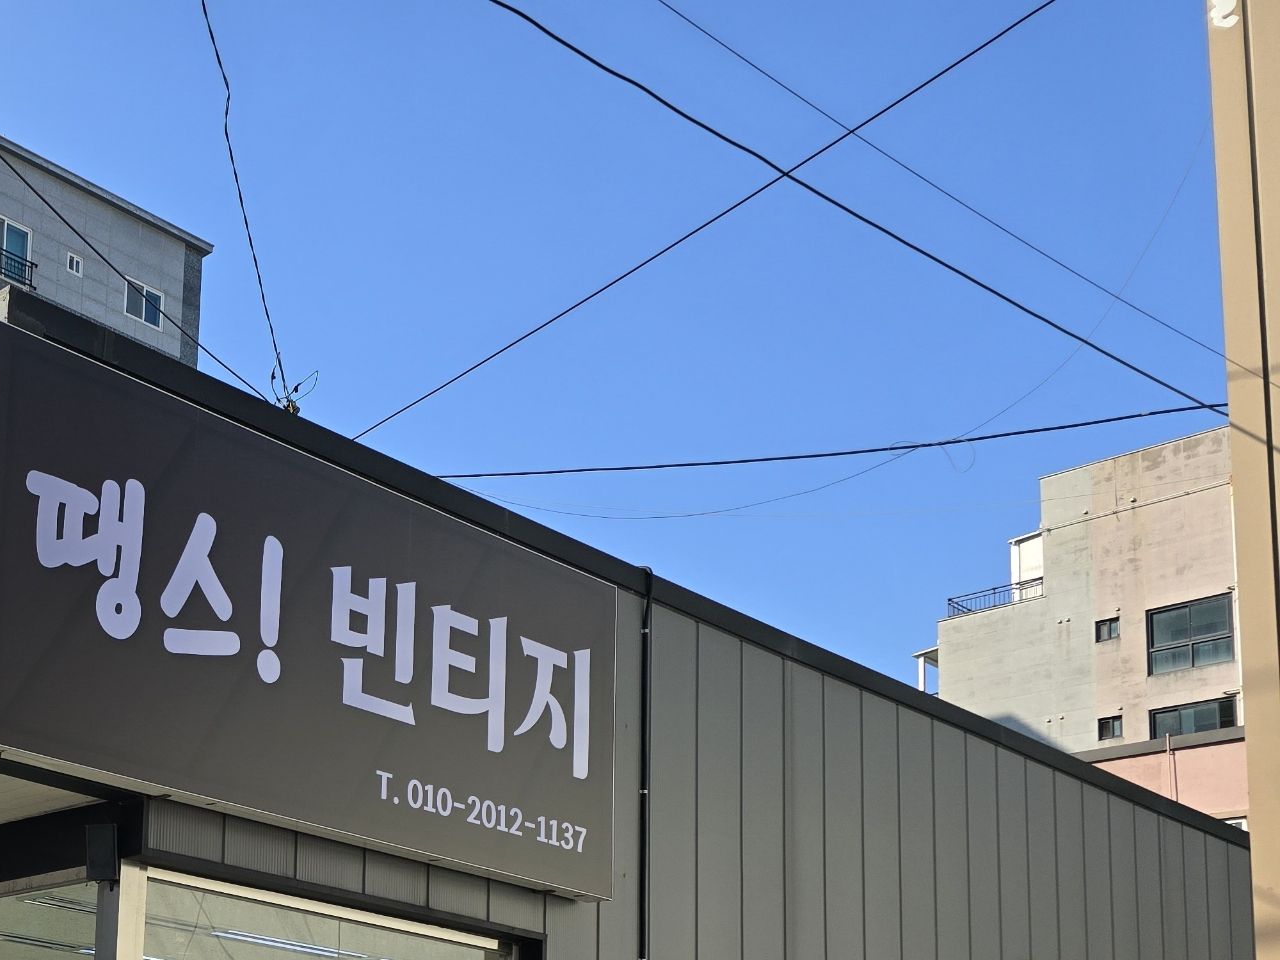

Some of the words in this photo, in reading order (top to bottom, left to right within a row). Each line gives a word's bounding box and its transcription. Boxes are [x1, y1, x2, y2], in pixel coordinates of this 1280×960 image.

[26, 469, 284, 684] 땡스!
[330, 565, 591, 780] 빈티지
[376, 770, 400, 805] T.
[407, 778, 588, 853] 010-2012-1137
